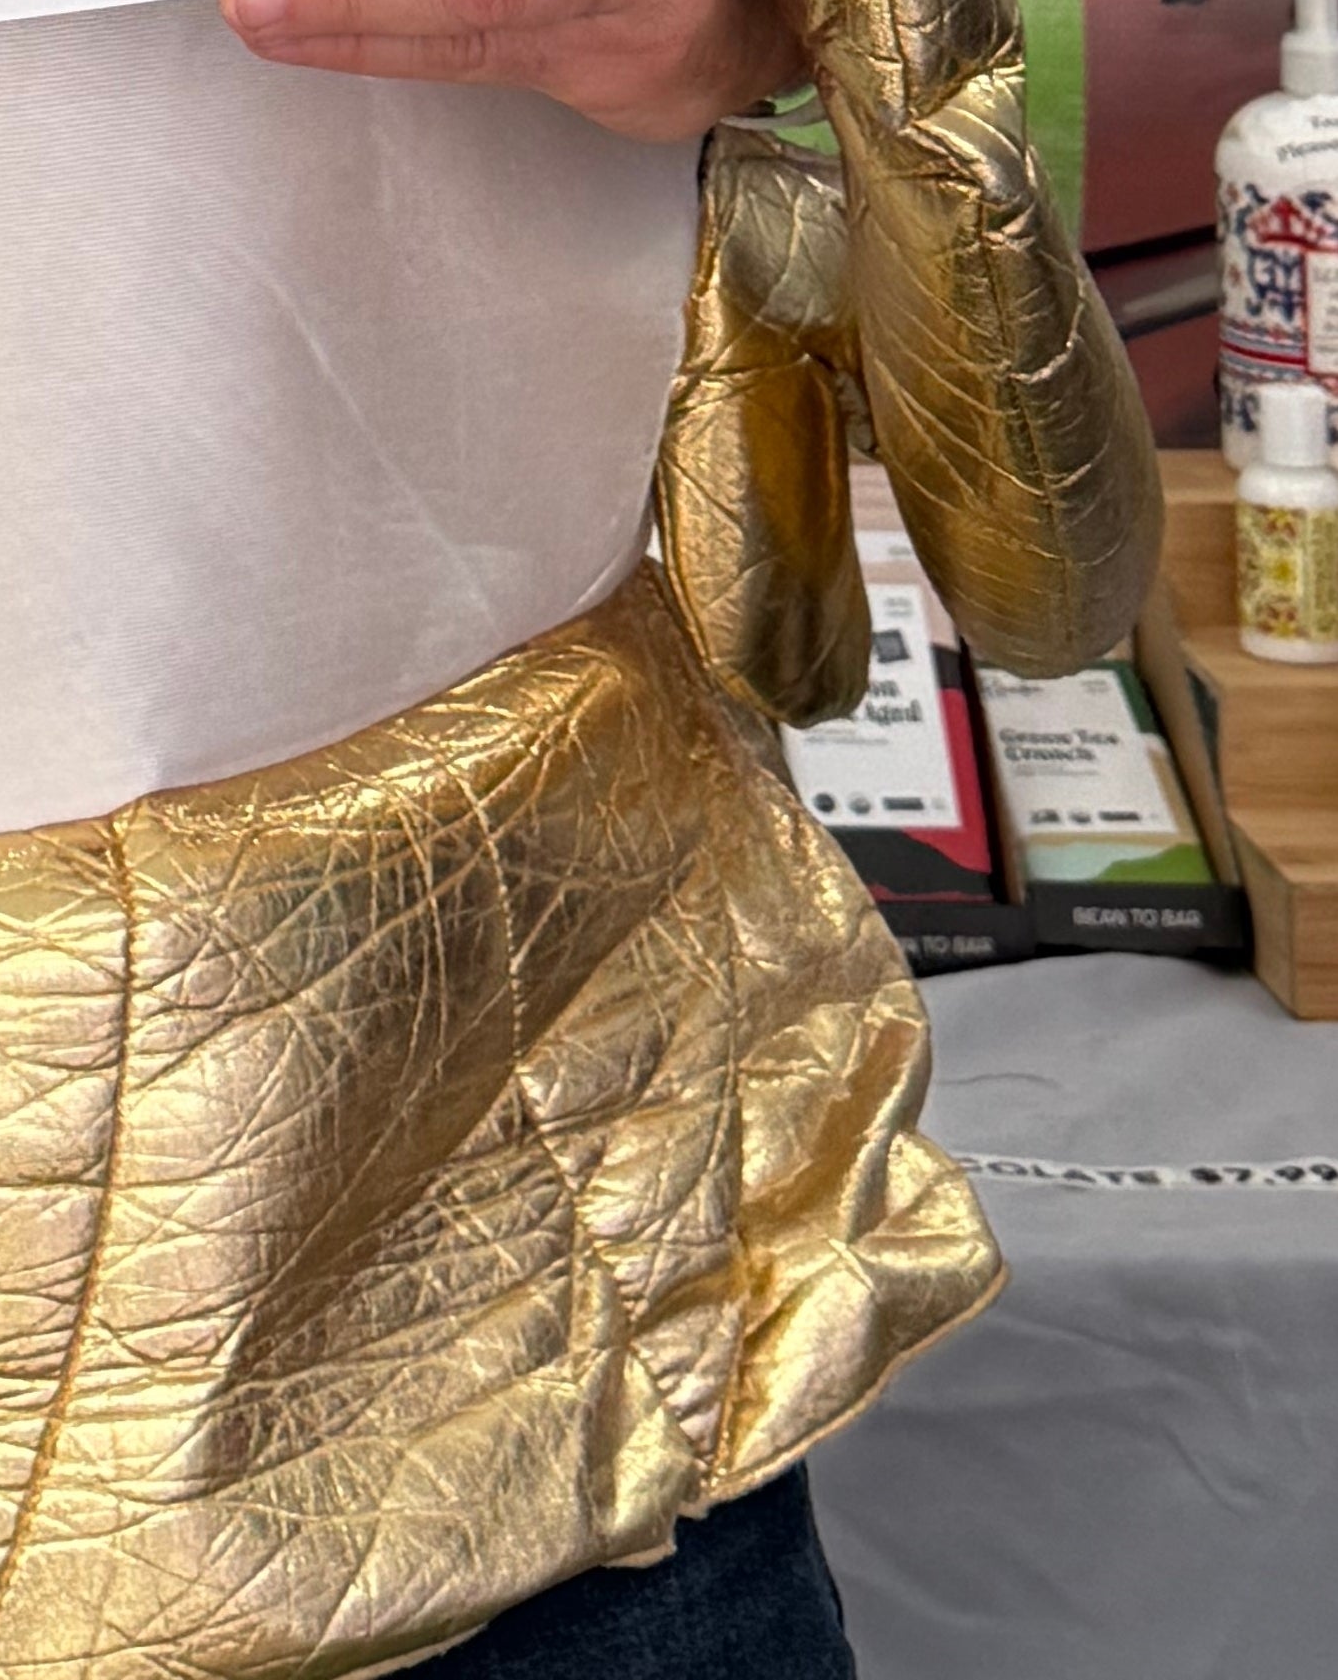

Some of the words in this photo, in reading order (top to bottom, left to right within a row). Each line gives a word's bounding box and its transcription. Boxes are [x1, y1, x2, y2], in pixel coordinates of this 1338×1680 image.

[1072, 906, 1126, 927] BEAN
[1129, 907, 1159, 927] TO
[1161, 908, 1203, 929] BAR
